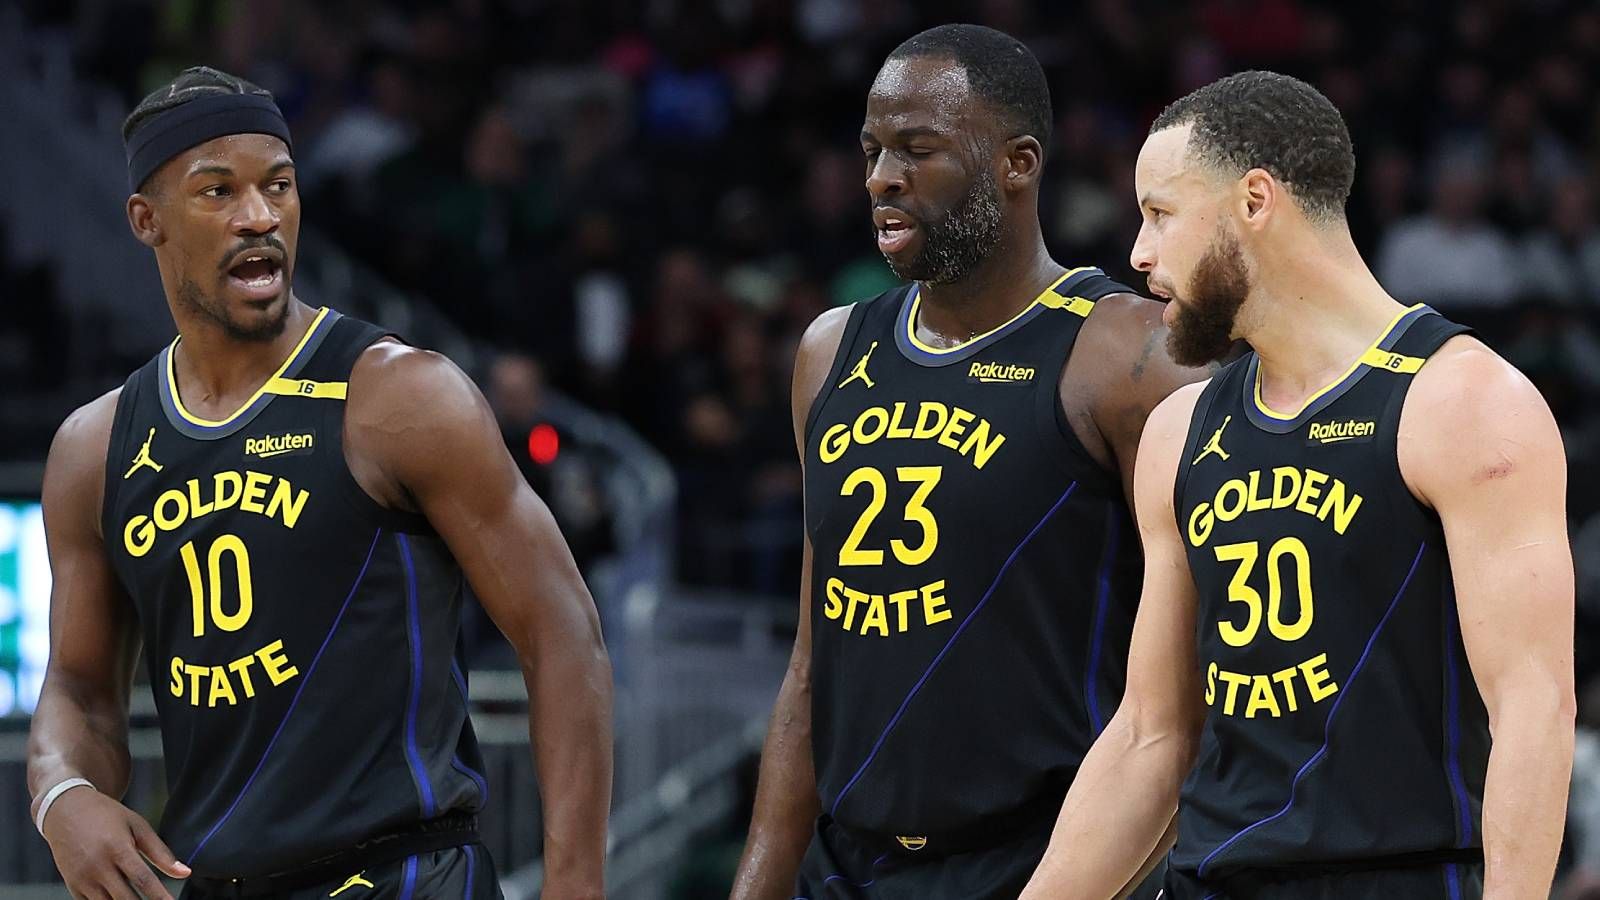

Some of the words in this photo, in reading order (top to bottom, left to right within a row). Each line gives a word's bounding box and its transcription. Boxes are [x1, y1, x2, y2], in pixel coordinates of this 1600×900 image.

[297, 382, 315, 394] 16
[968, 361, 1035, 381] Rakuten
[1385, 355, 1403, 369] 16
[244, 432, 313, 455] Rakuten
[819, 401, 1006, 469] GOLDEN
[1308, 419, 1375, 440] Rakuten
[123, 470, 309, 557] GOLDEN
[838, 465, 943, 567] 23
[1187, 466, 1364, 547] GOLDEN
[180, 534, 253, 637] 10
[823, 576, 952, 637] STATE
[1213, 536, 1313, 647] 30
[170, 639, 299, 707] STATE
[1204, 652, 1340, 719] STATE
